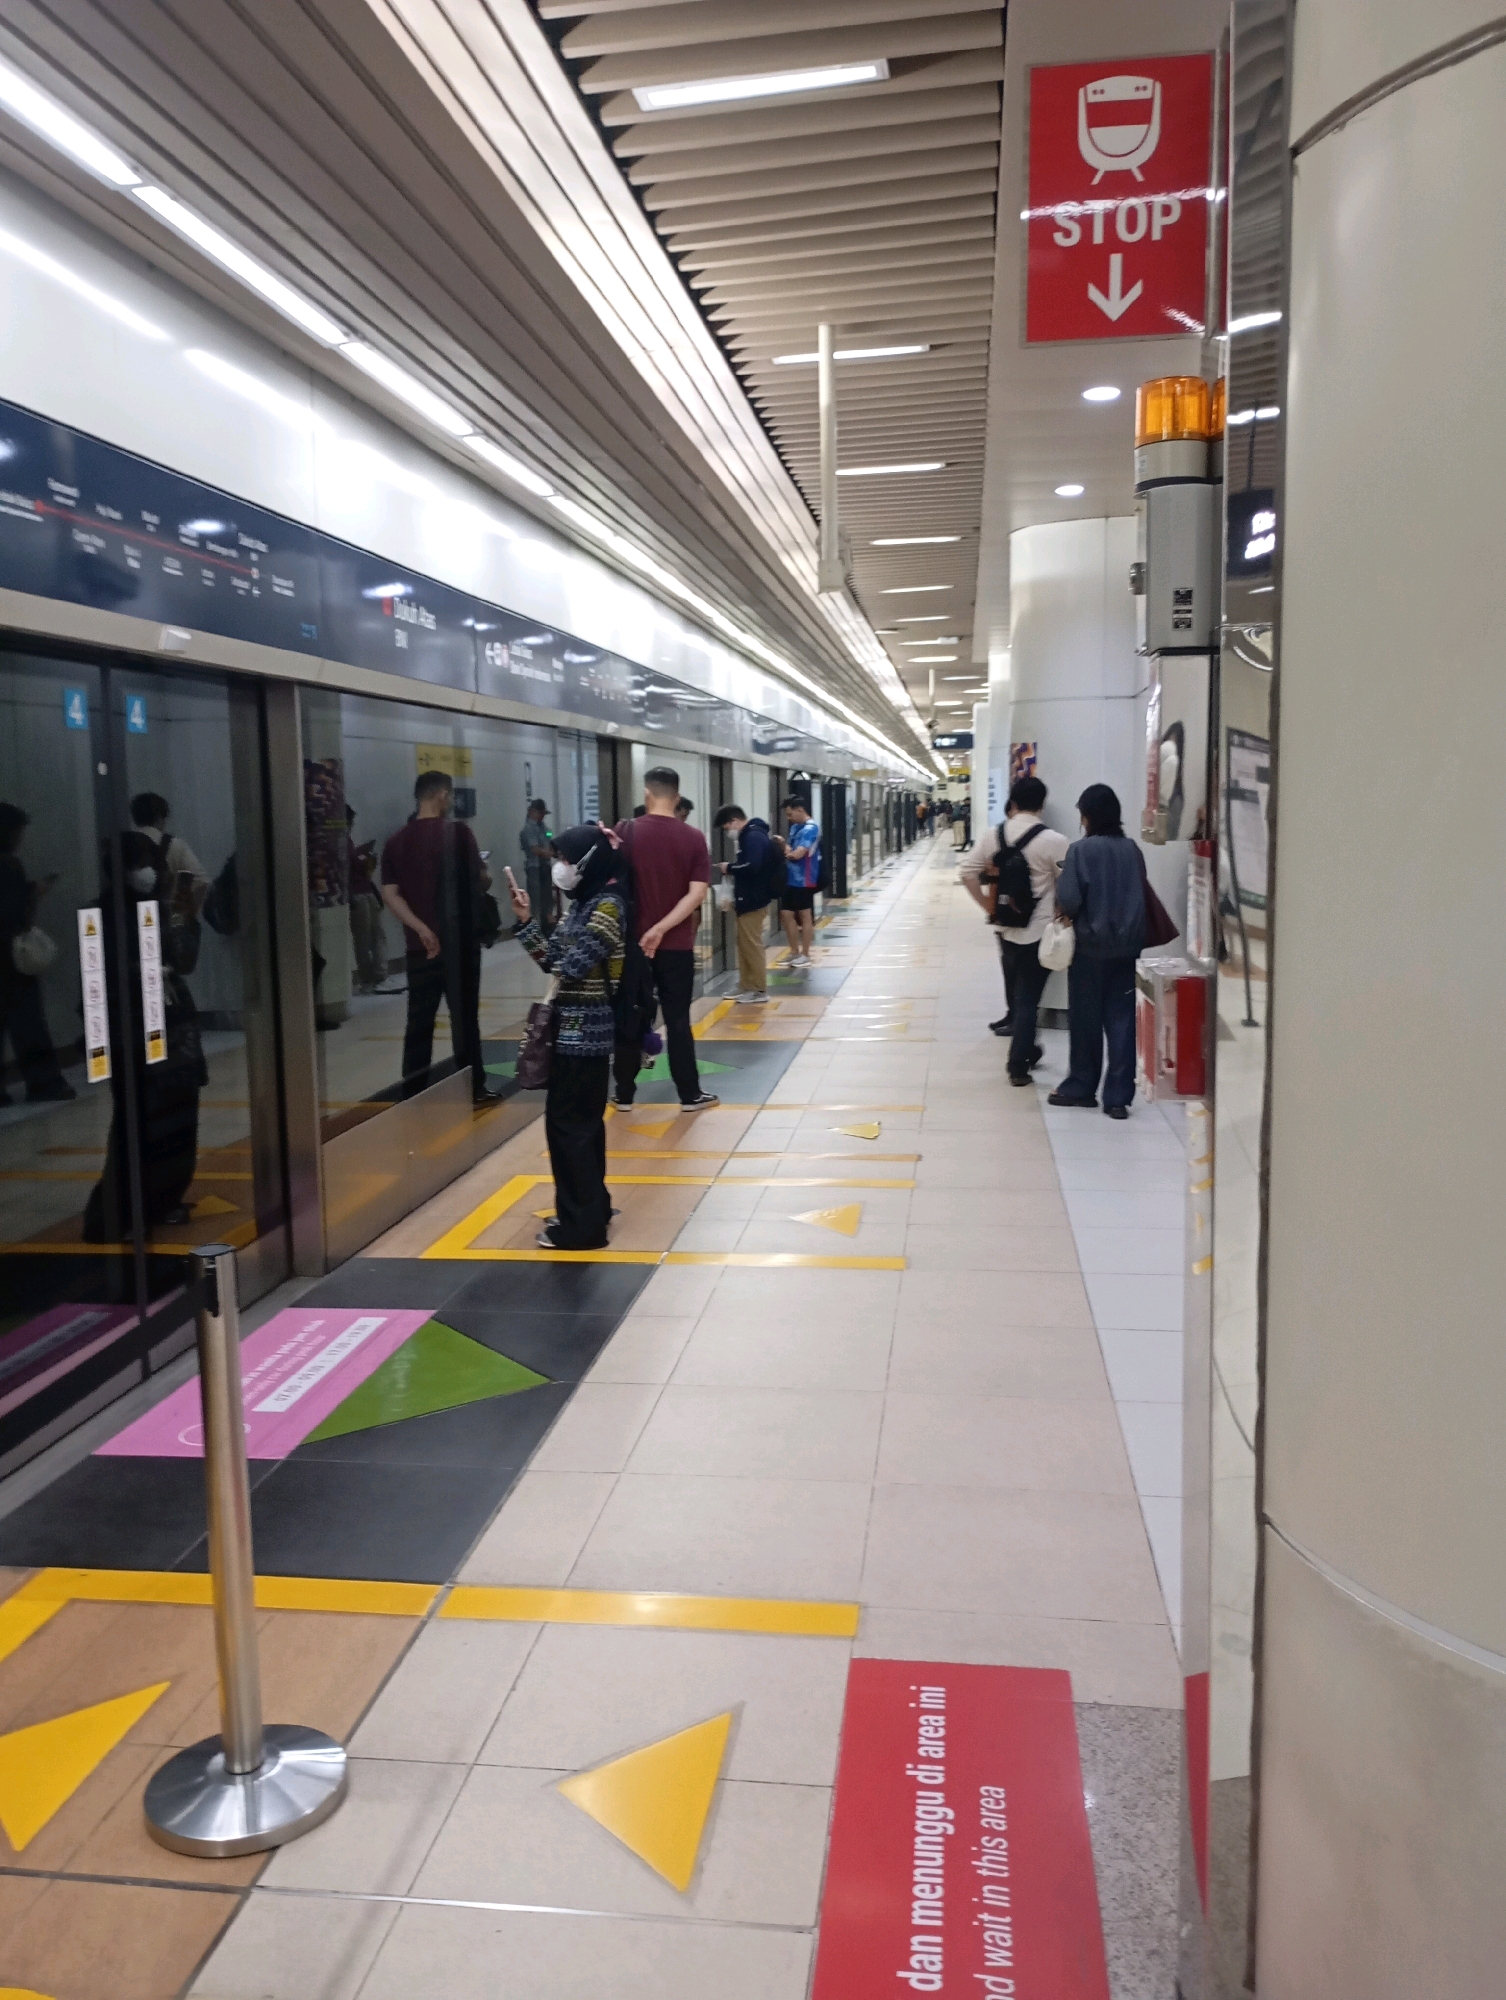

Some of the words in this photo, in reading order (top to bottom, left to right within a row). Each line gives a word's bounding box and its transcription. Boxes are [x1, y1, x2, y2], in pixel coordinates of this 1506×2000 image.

[1053, 197, 1181, 247] STOP
[68, 693, 85, 725] 4
[130, 699, 145, 729] 4
[908, 1685, 946, 1710] ini
[917, 1715, 946, 1759] area
[905, 1763, 945, 1785] di
[979, 1785, 1008, 1830] area
[911, 1790, 955, 1926] menunggu
[971, 1836, 1010, 1878] this
[972, 1885, 1011, 1907] in
[972, 1912, 1014, 1967] wait
[896, 1935, 944, 1991] dan
